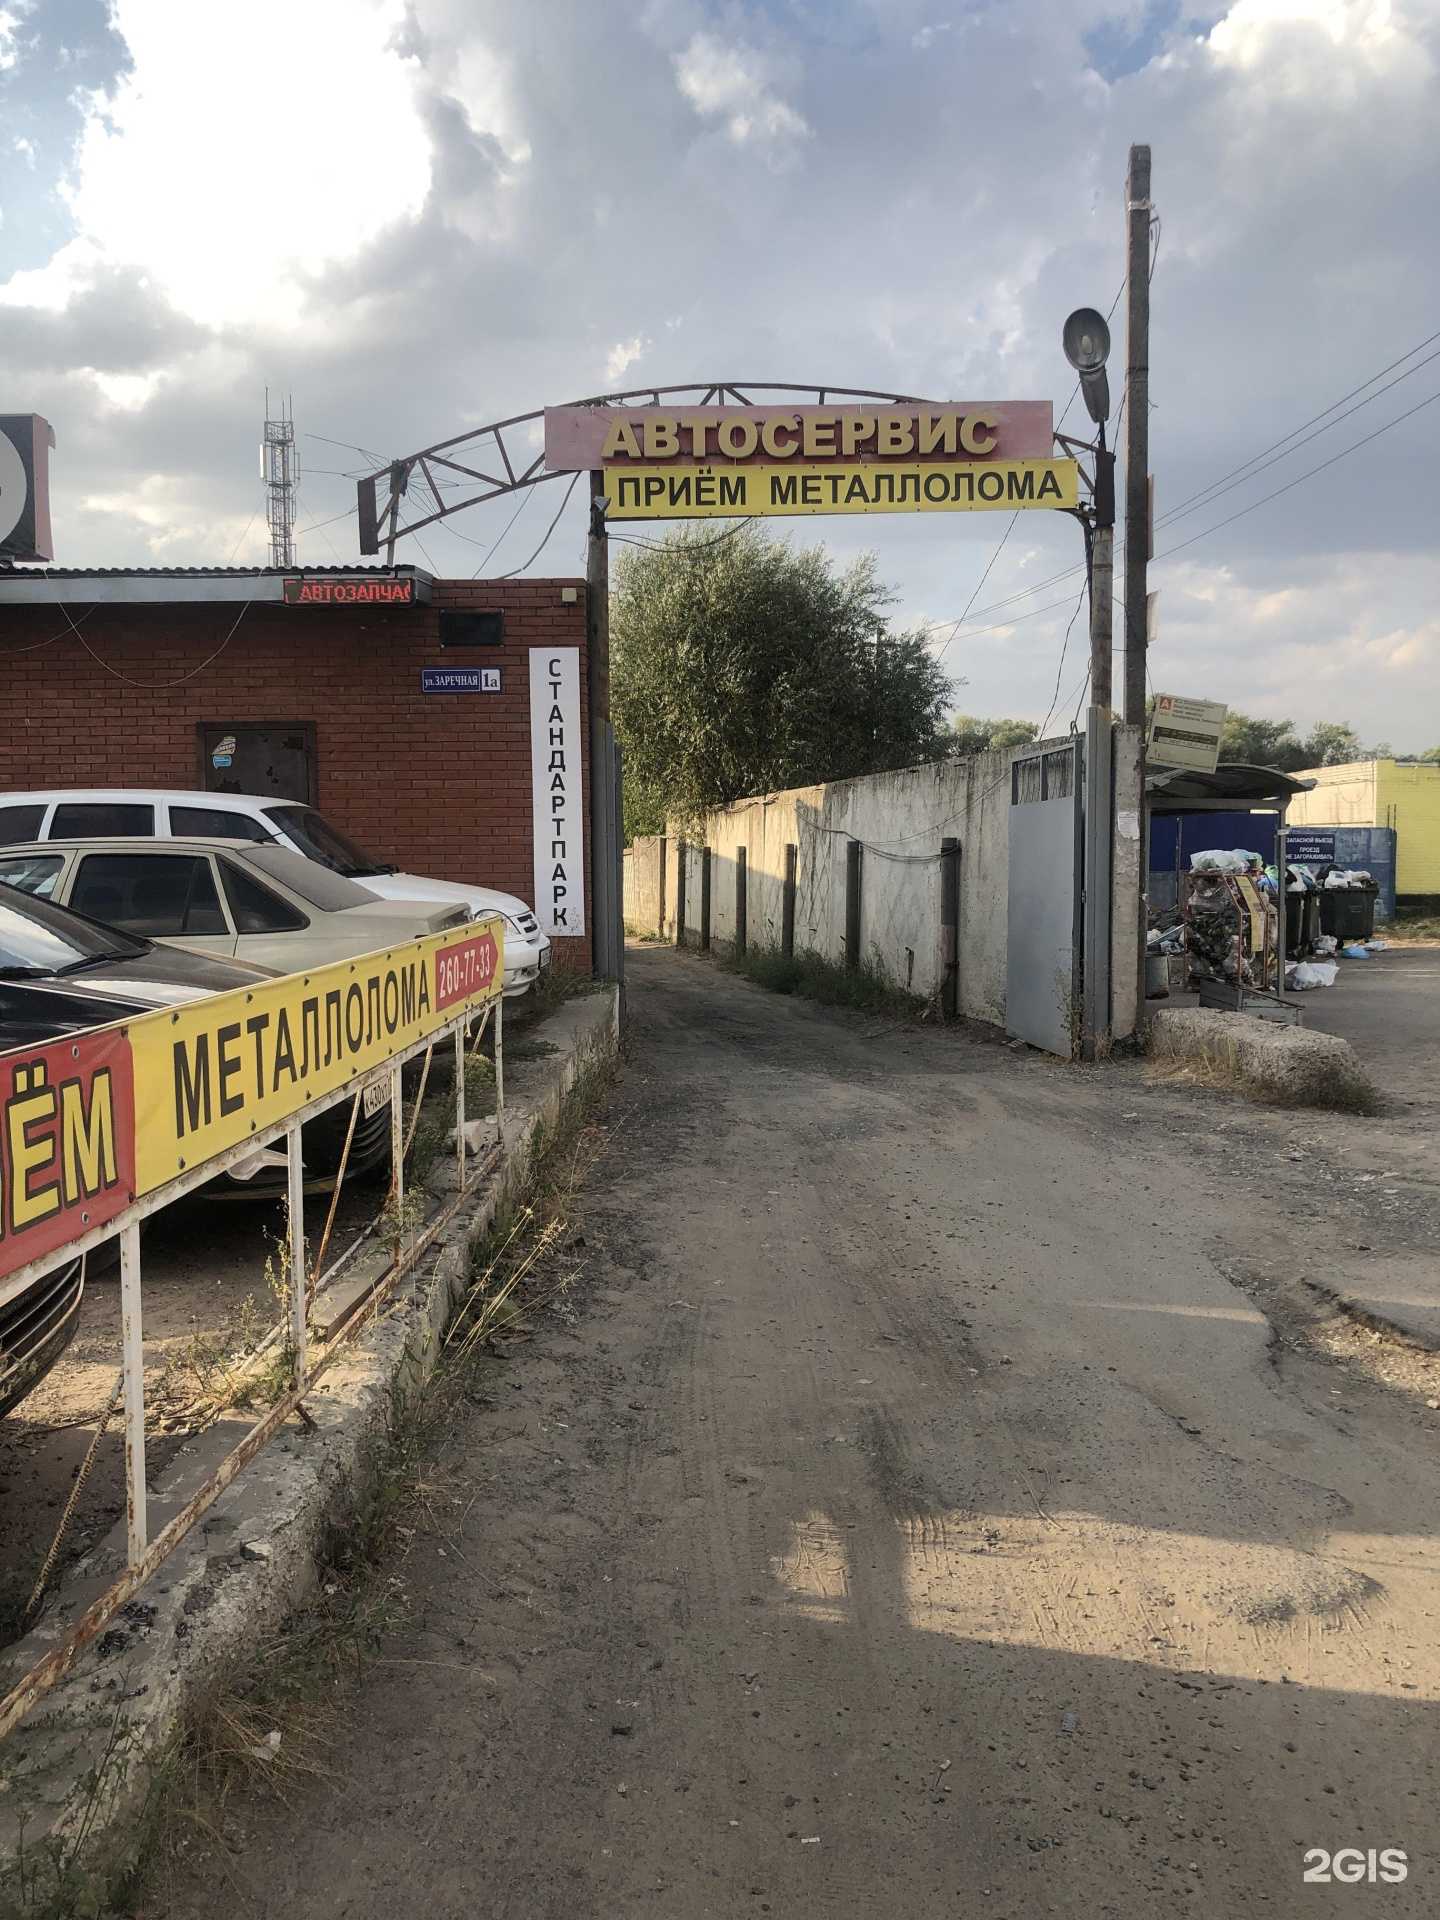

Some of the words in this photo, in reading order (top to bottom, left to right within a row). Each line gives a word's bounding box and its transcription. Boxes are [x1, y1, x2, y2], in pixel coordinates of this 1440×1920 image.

[602, 413, 998, 459] АВТОСЕРВИС
[618, 466, 746, 507] ПРИЁМ
[770, 470, 1063, 505] МЕТАЛЛОЛОМА
[483, 672, 498, 688] 1а
[547, 658, 568, 926] СТАНДАРТПАРК
[0, 1057, 119, 1240] ЁМ
[173, 959, 430, 1139] МЕТАЛЛОЛОМА
[439, 943, 491, 999] 260-77-33
